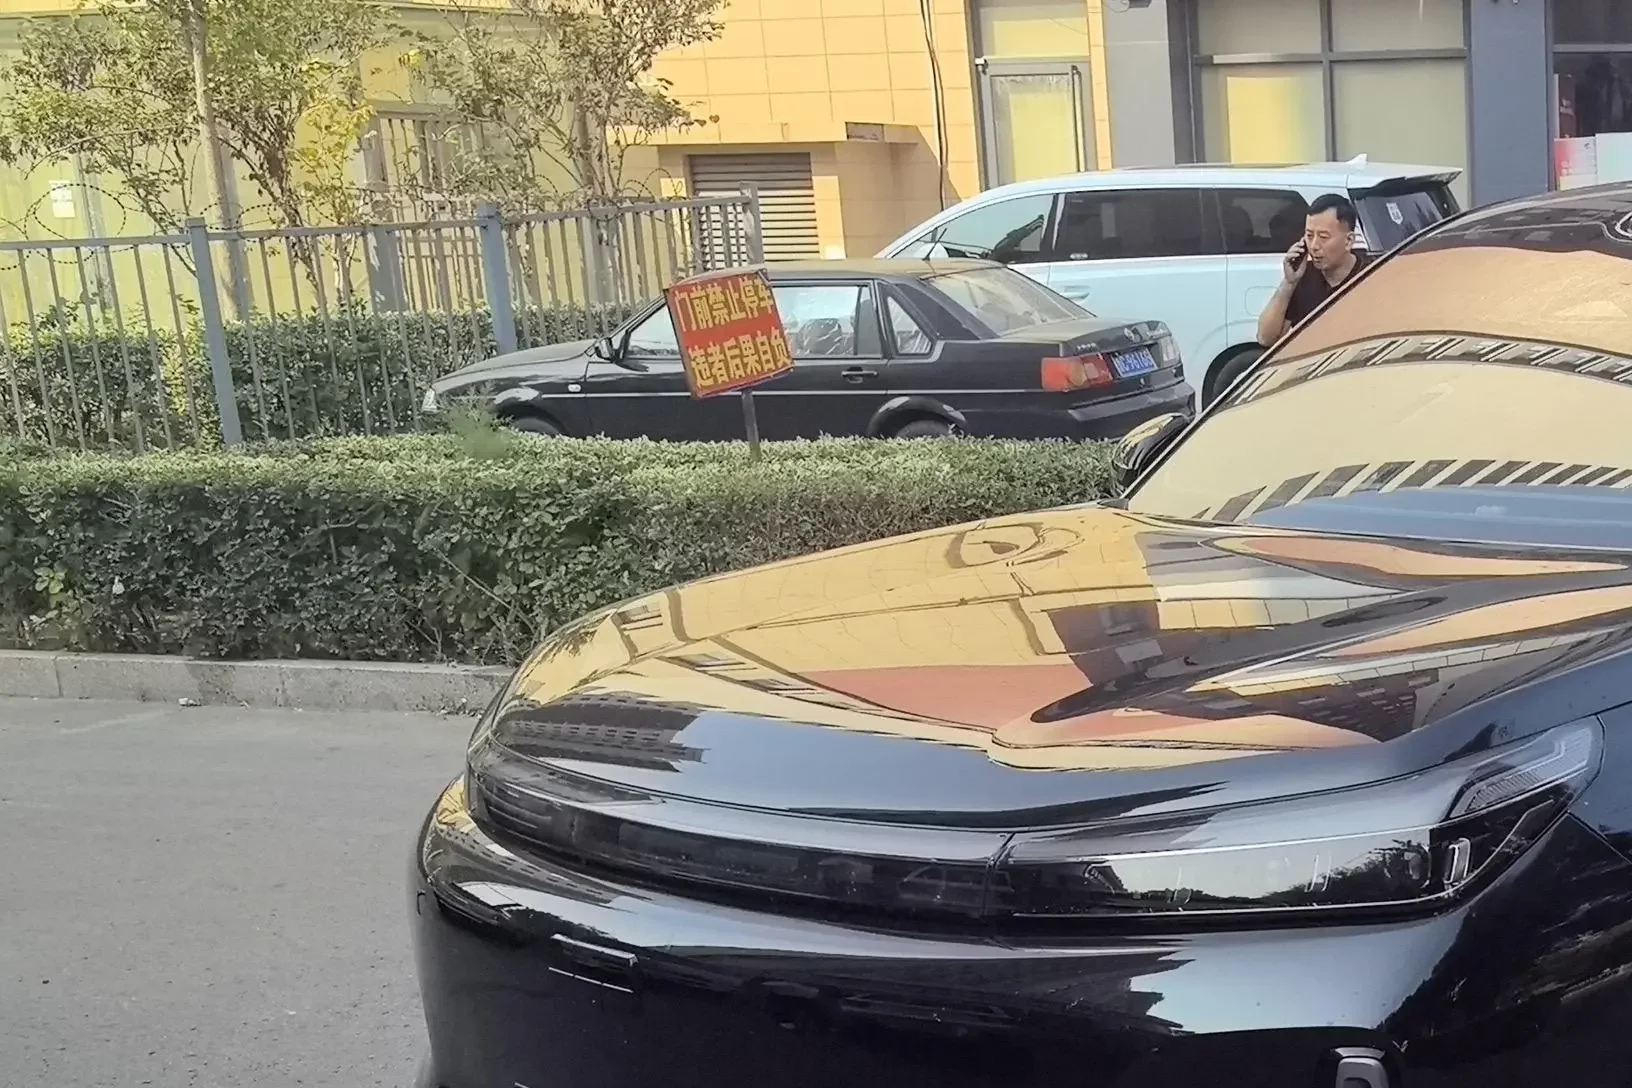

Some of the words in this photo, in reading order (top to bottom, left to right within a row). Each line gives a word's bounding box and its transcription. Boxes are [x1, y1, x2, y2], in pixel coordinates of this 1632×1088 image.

[674, 275, 774, 332] 门前禁止停车
[688, 326, 793, 389] 违者后果自负
